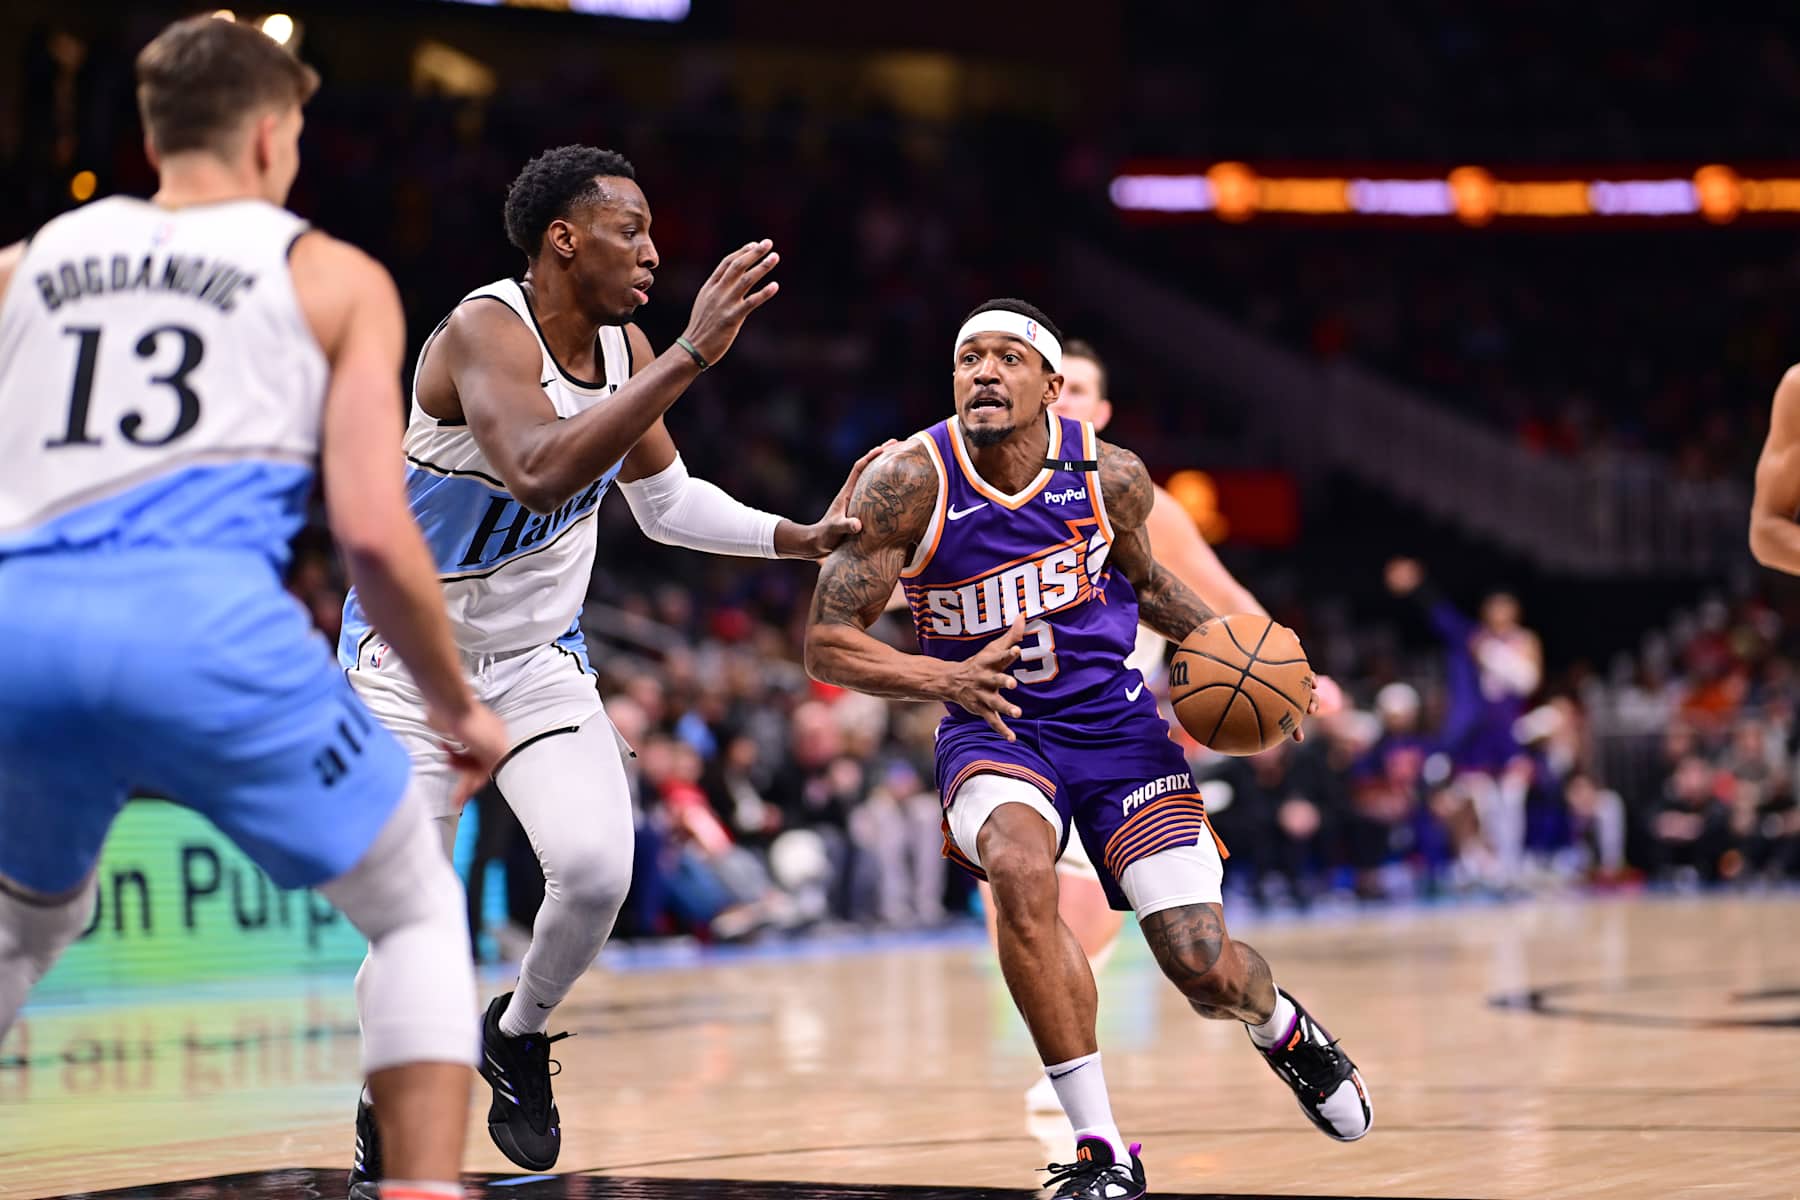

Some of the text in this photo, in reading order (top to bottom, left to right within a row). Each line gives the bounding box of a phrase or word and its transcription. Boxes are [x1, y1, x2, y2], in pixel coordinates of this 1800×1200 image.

[43, 324, 205, 450] 13
[1064, 461, 1074, 472] AL
[1044, 486, 1087, 506] PayPal
[1013, 618, 1060, 685] 3
[1122, 772, 1192, 817] PHOENIX
